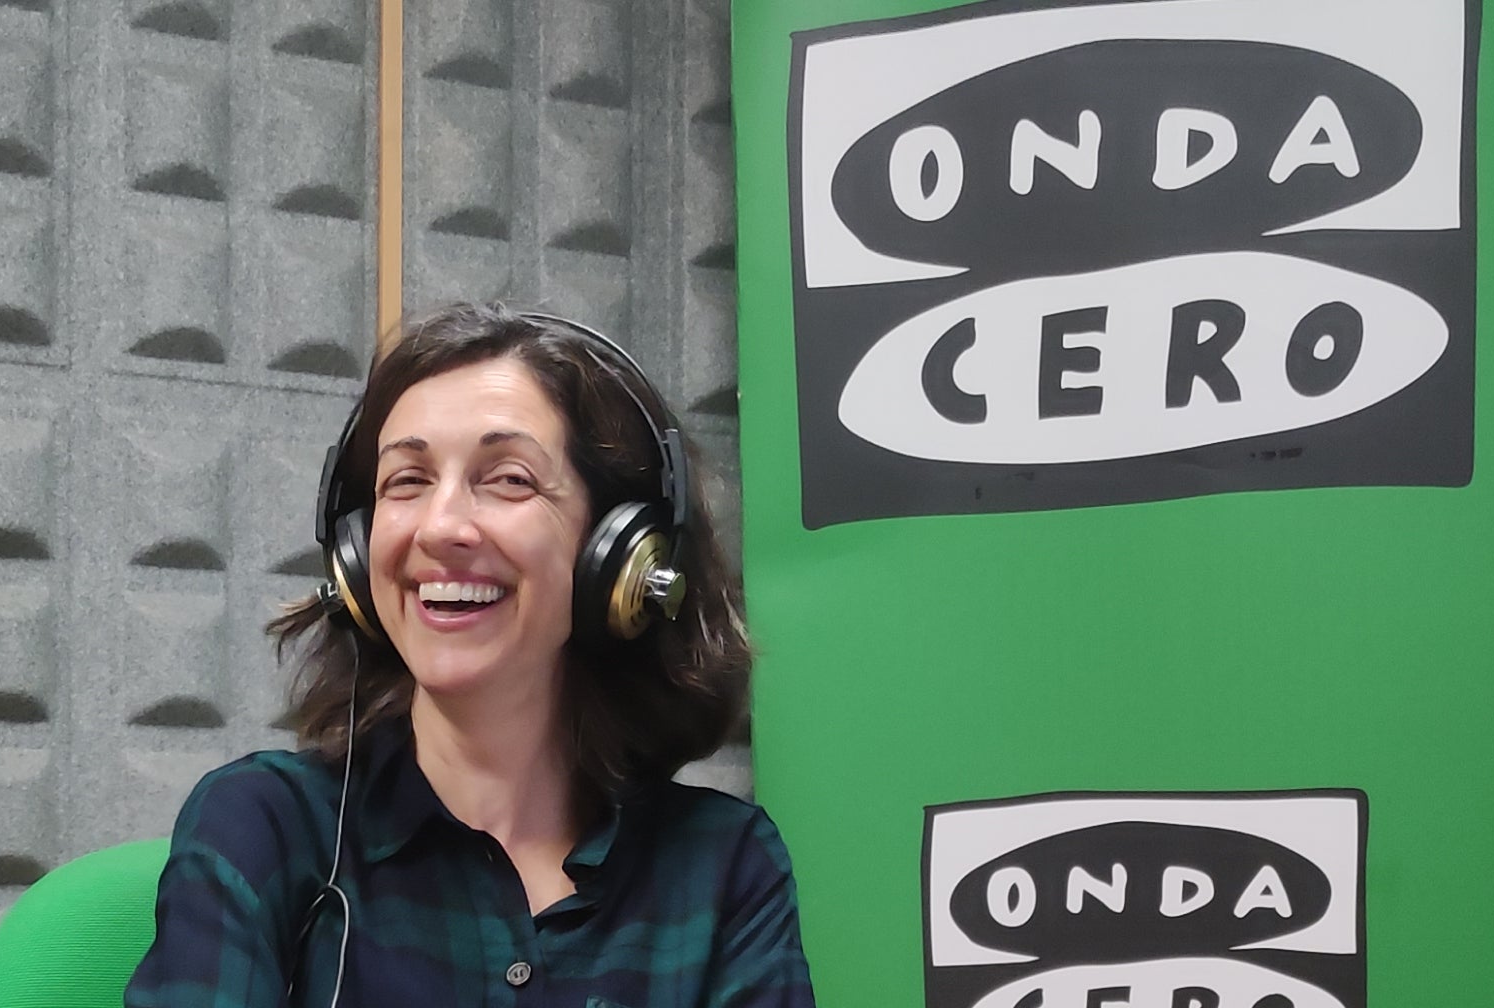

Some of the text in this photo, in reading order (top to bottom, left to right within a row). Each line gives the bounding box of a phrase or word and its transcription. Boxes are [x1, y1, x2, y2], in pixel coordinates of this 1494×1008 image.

[889, 95, 1361, 222] ONDA
[921, 299, 1364, 425] CERO
[986, 862, 1293, 928] ONDA
